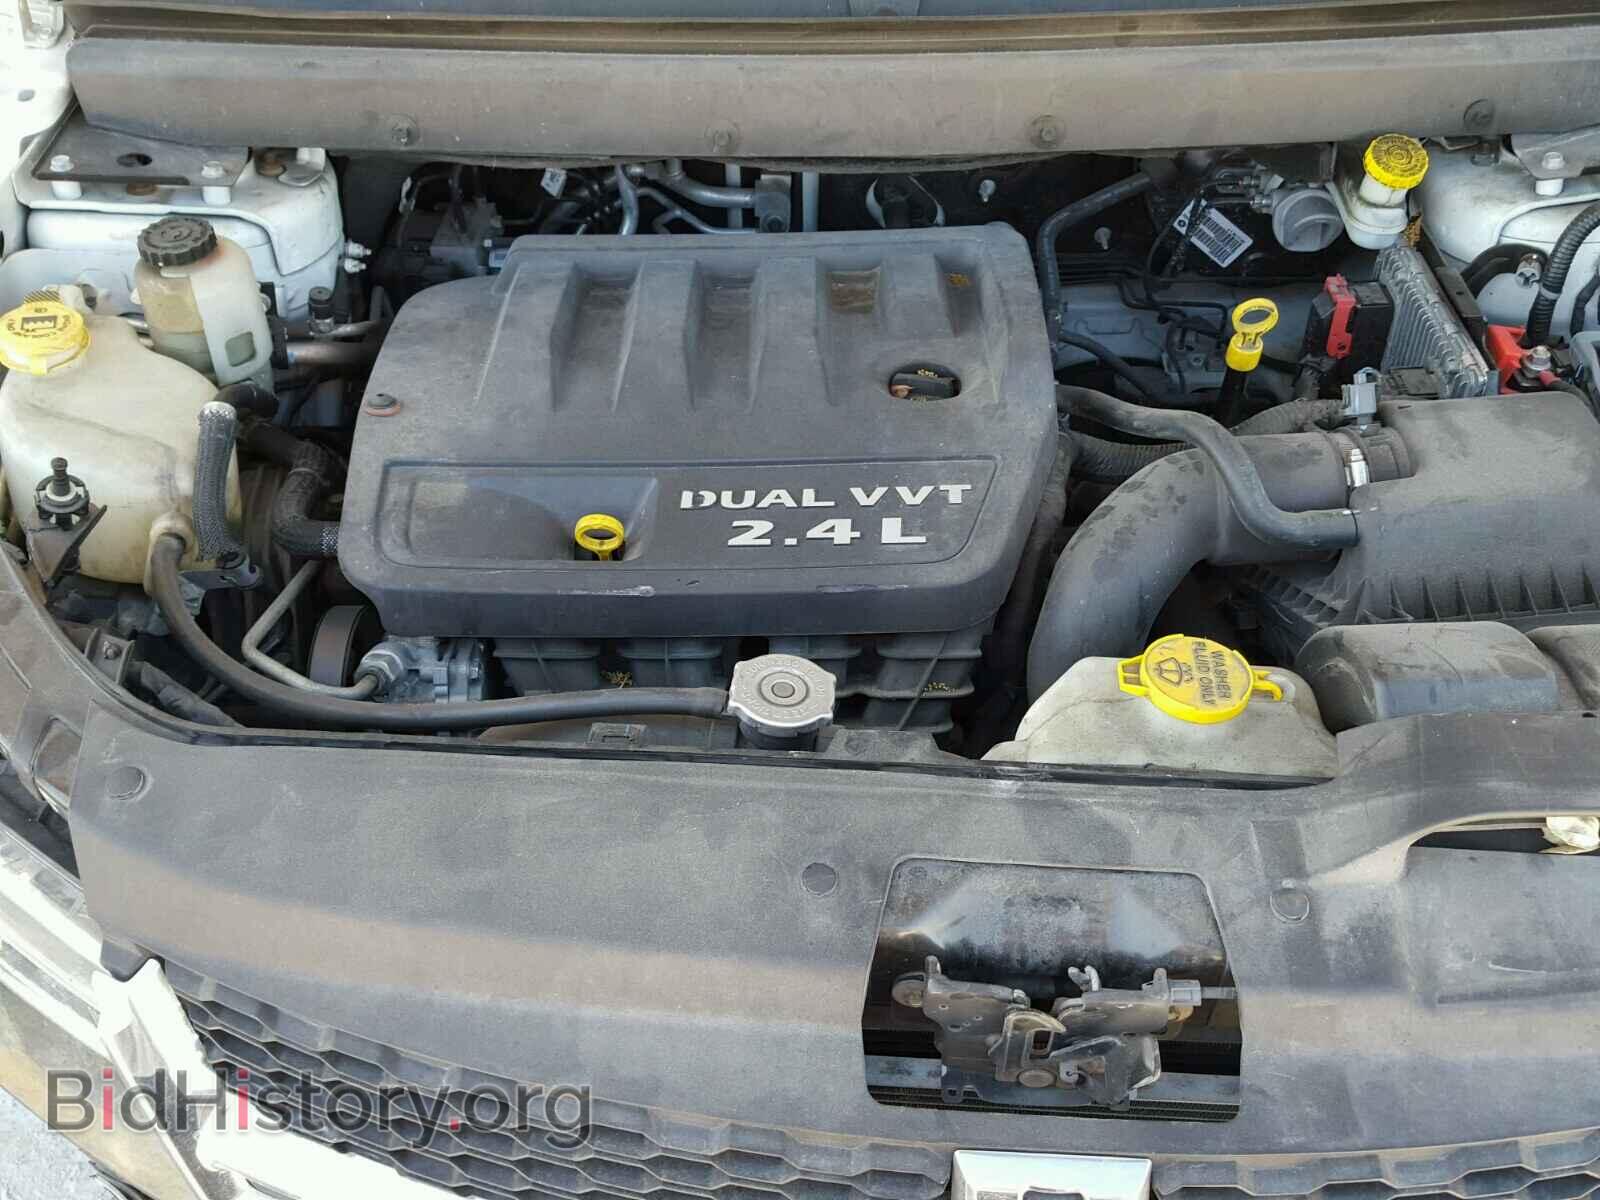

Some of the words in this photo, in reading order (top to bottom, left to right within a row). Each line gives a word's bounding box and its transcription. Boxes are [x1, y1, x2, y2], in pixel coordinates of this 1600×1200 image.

[680, 488, 836, 510] DUAL
[849, 484, 973, 506] VVT
[1192, 641, 1210, 673] FLUID
[1211, 651, 1232, 699] WASHER
[1200, 676, 1217, 705] ONLY
